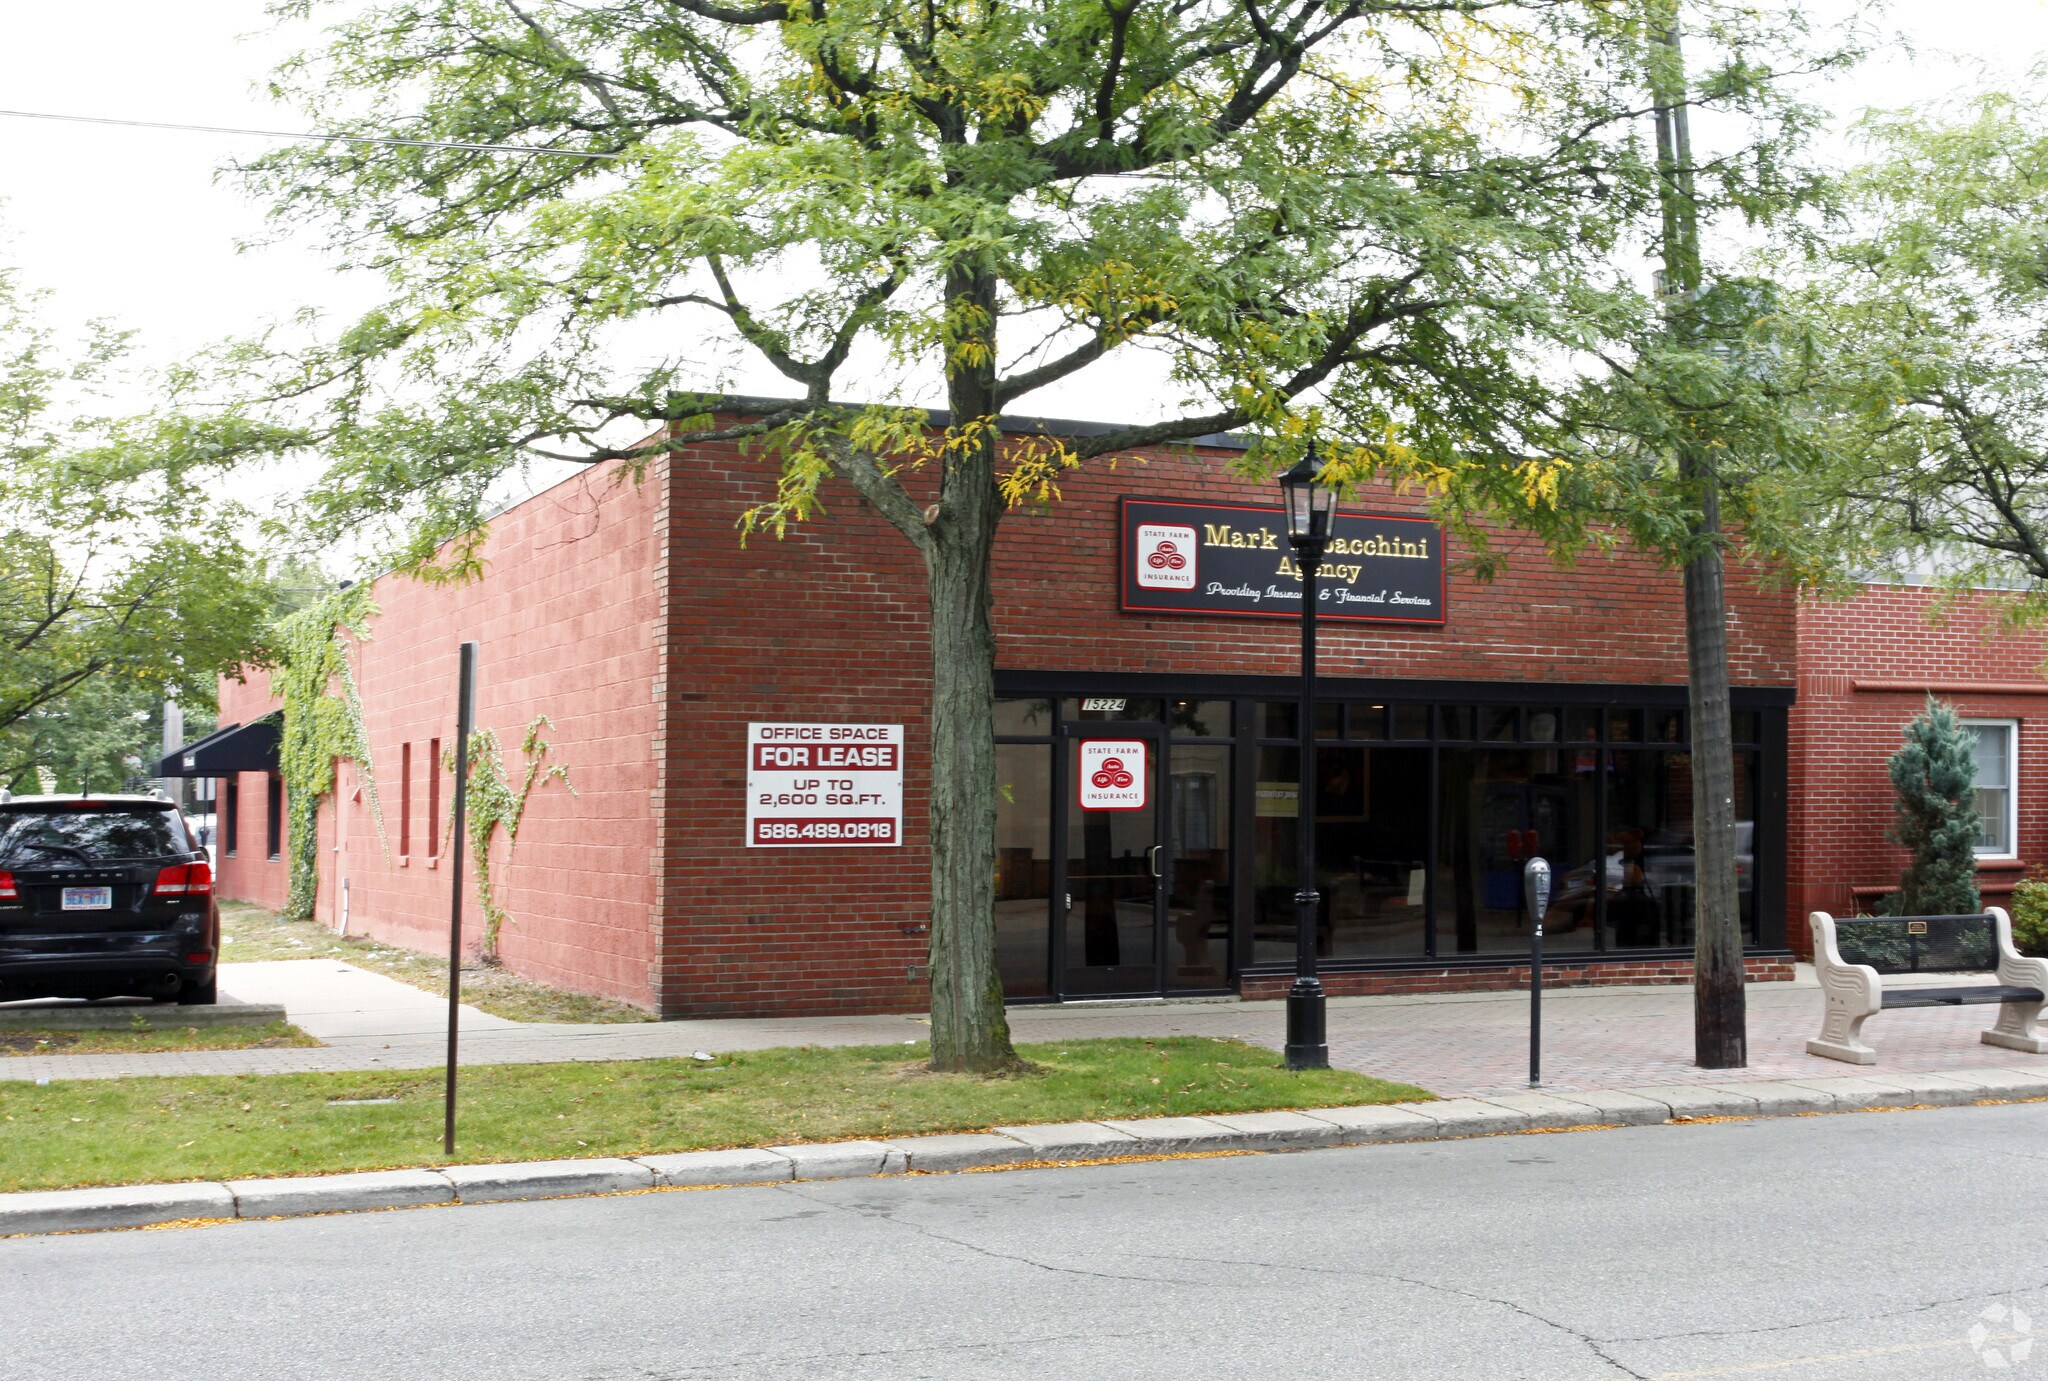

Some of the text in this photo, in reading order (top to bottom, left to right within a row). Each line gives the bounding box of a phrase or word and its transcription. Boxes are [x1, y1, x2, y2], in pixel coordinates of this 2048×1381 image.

[1203, 523, 1279, 550] Mark
[1206, 581, 1261, 602] Providing
[1319, 588, 1331, 600] &
[1334, 587, 1387, 604] Financial
[1389, 590, 1432, 606] Services
[1086, 699, 1125, 710] 15224
[760, 727, 889, 740] OFFICE SPACE
[760, 747, 892, 767] FOR LEASE
[794, 779, 853, 790] UP TO
[760, 793, 885, 808] 2,600 SQ.FT.
[759, 823, 891, 838] 586.489.0818
